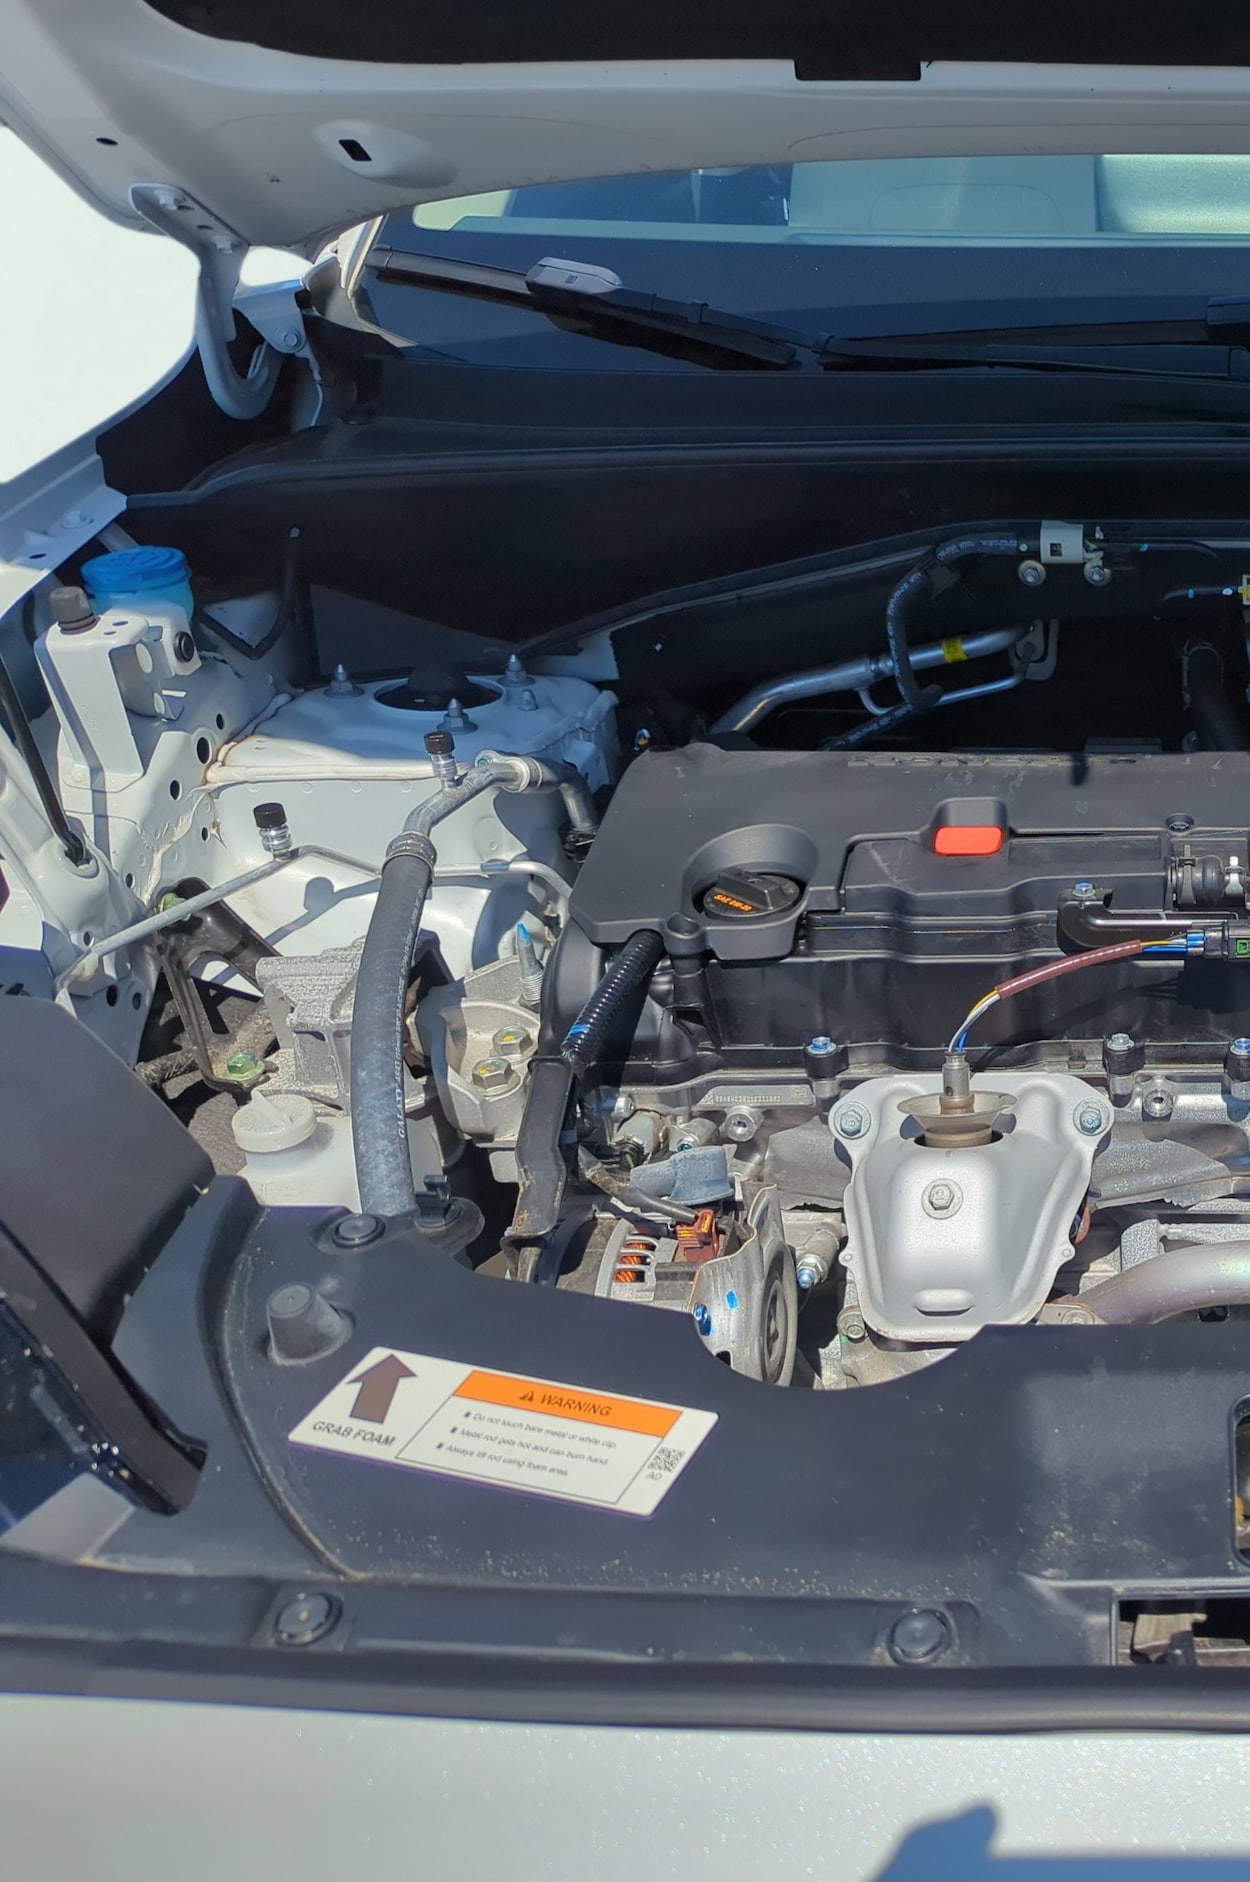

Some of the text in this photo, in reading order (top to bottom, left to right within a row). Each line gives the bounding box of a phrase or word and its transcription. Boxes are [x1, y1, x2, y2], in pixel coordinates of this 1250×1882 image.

[395, 1084, 406, 1138] GALAXY
[541, 1393, 613, 1417] WARNING
[312, 1420, 396, 1447] GRAB FOAM
[459, 1428, 484, 1439] Metal
[484, 1433, 499, 1442] rod
[517, 1439, 531, 1449] hot
[532, 1443, 549, 1453] and
[549, 1448, 565, 1457] can
[473, 1412, 485, 1421] Do
[486, 1416, 501, 1425] not
[501, 1418, 523, 1430] touch
[544, 1427, 568, 1439] metal
[568, 1432, 578, 1440] or
[579, 1433, 600, 1445] white
[445, 1444, 475, 1457] Always
[526, 1461, 548, 1471] foam
